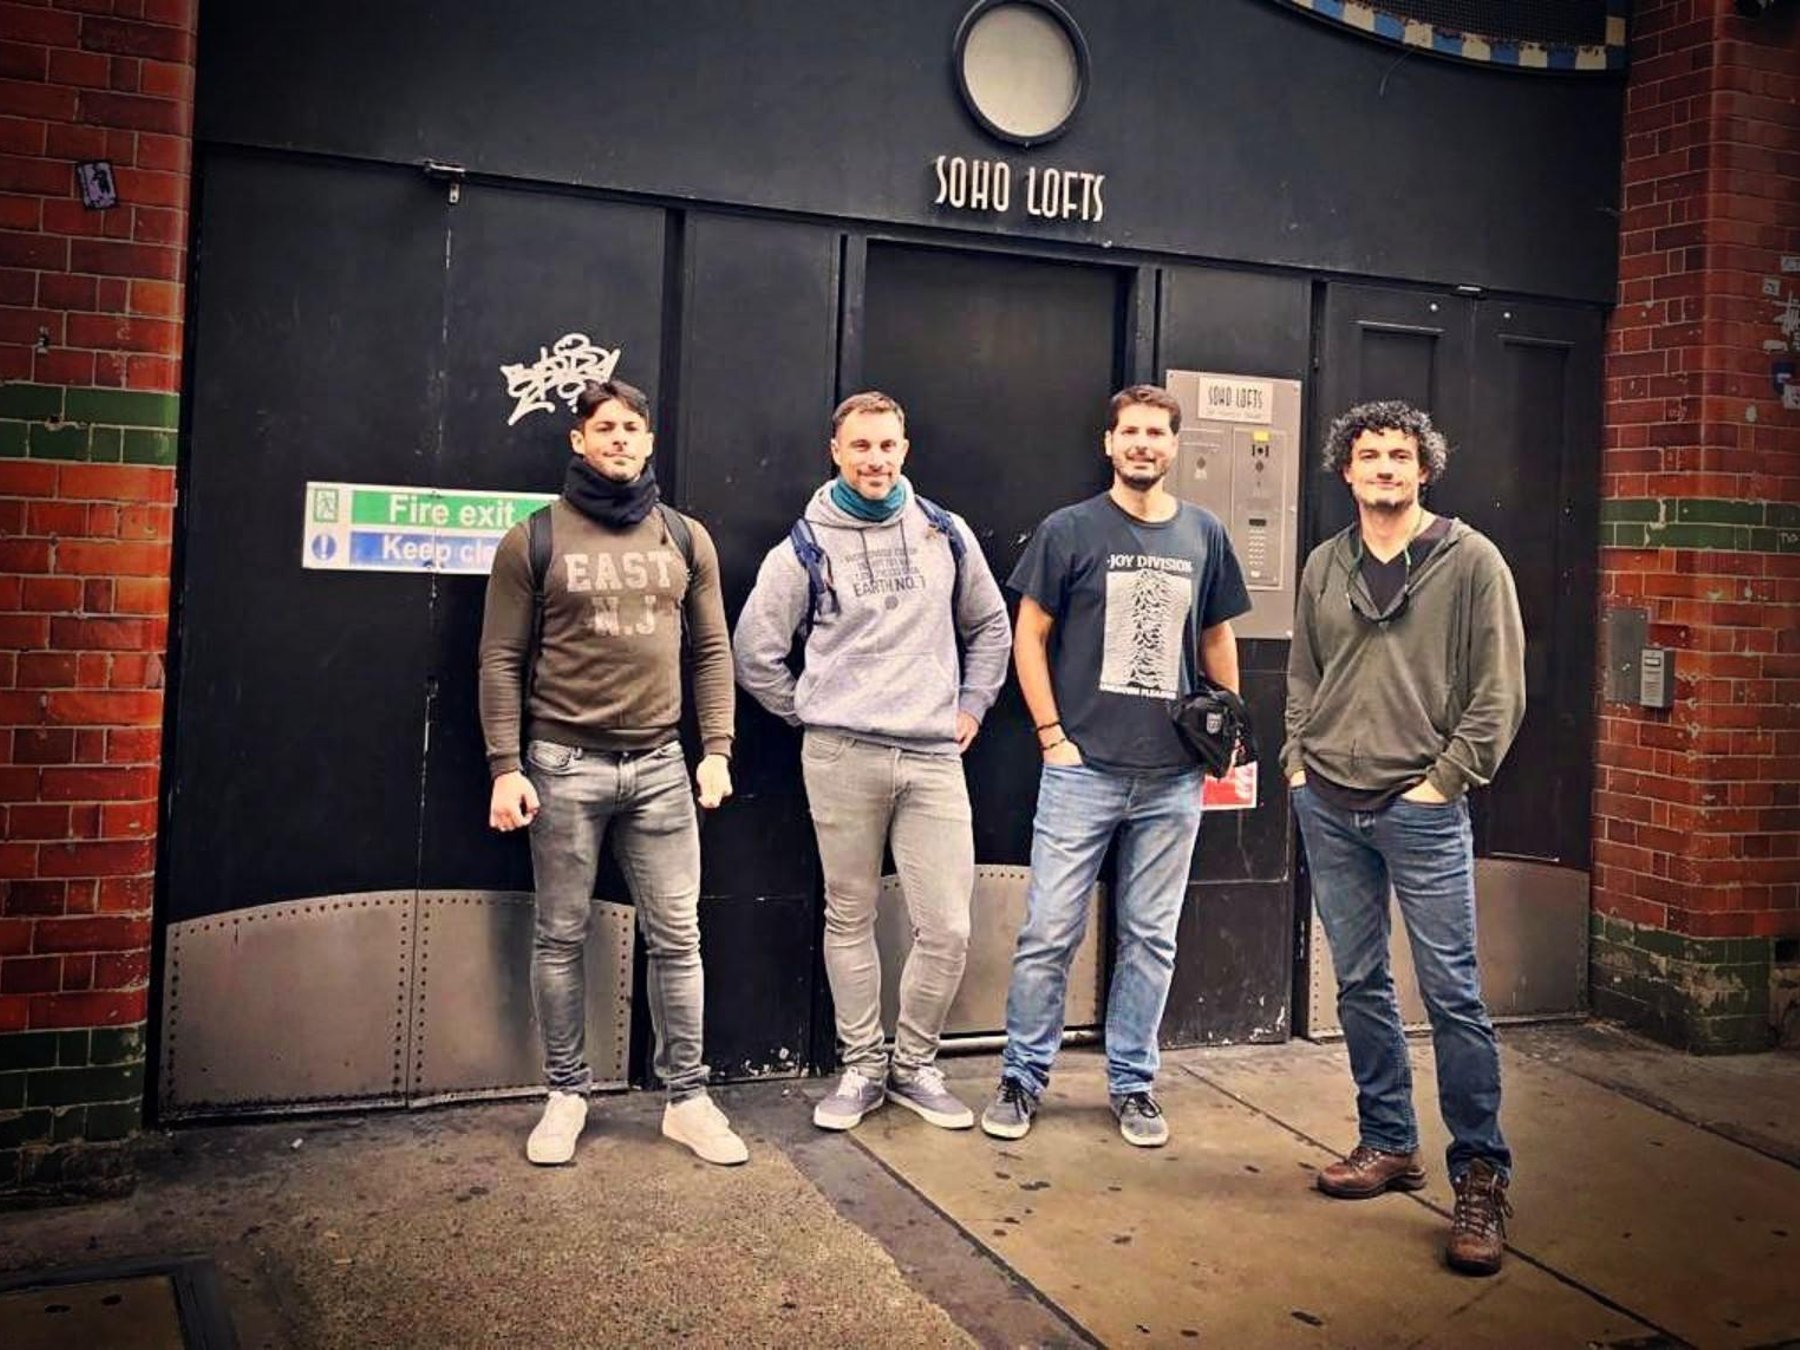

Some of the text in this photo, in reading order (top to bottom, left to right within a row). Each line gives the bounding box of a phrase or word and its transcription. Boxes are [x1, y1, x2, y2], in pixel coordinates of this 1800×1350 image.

[935, 155, 1105, 222] SOHO LOFTS
[1208, 385, 1263, 409] SOHO LOFTS
[389, 494, 516, 530] Fire exit
[382, 534, 498, 567] Keep cle
[1107, 553, 1193, 573] JOY DIVISION
[564, 550, 673, 592] EAST
[852, 578, 894, 597] EARTH
